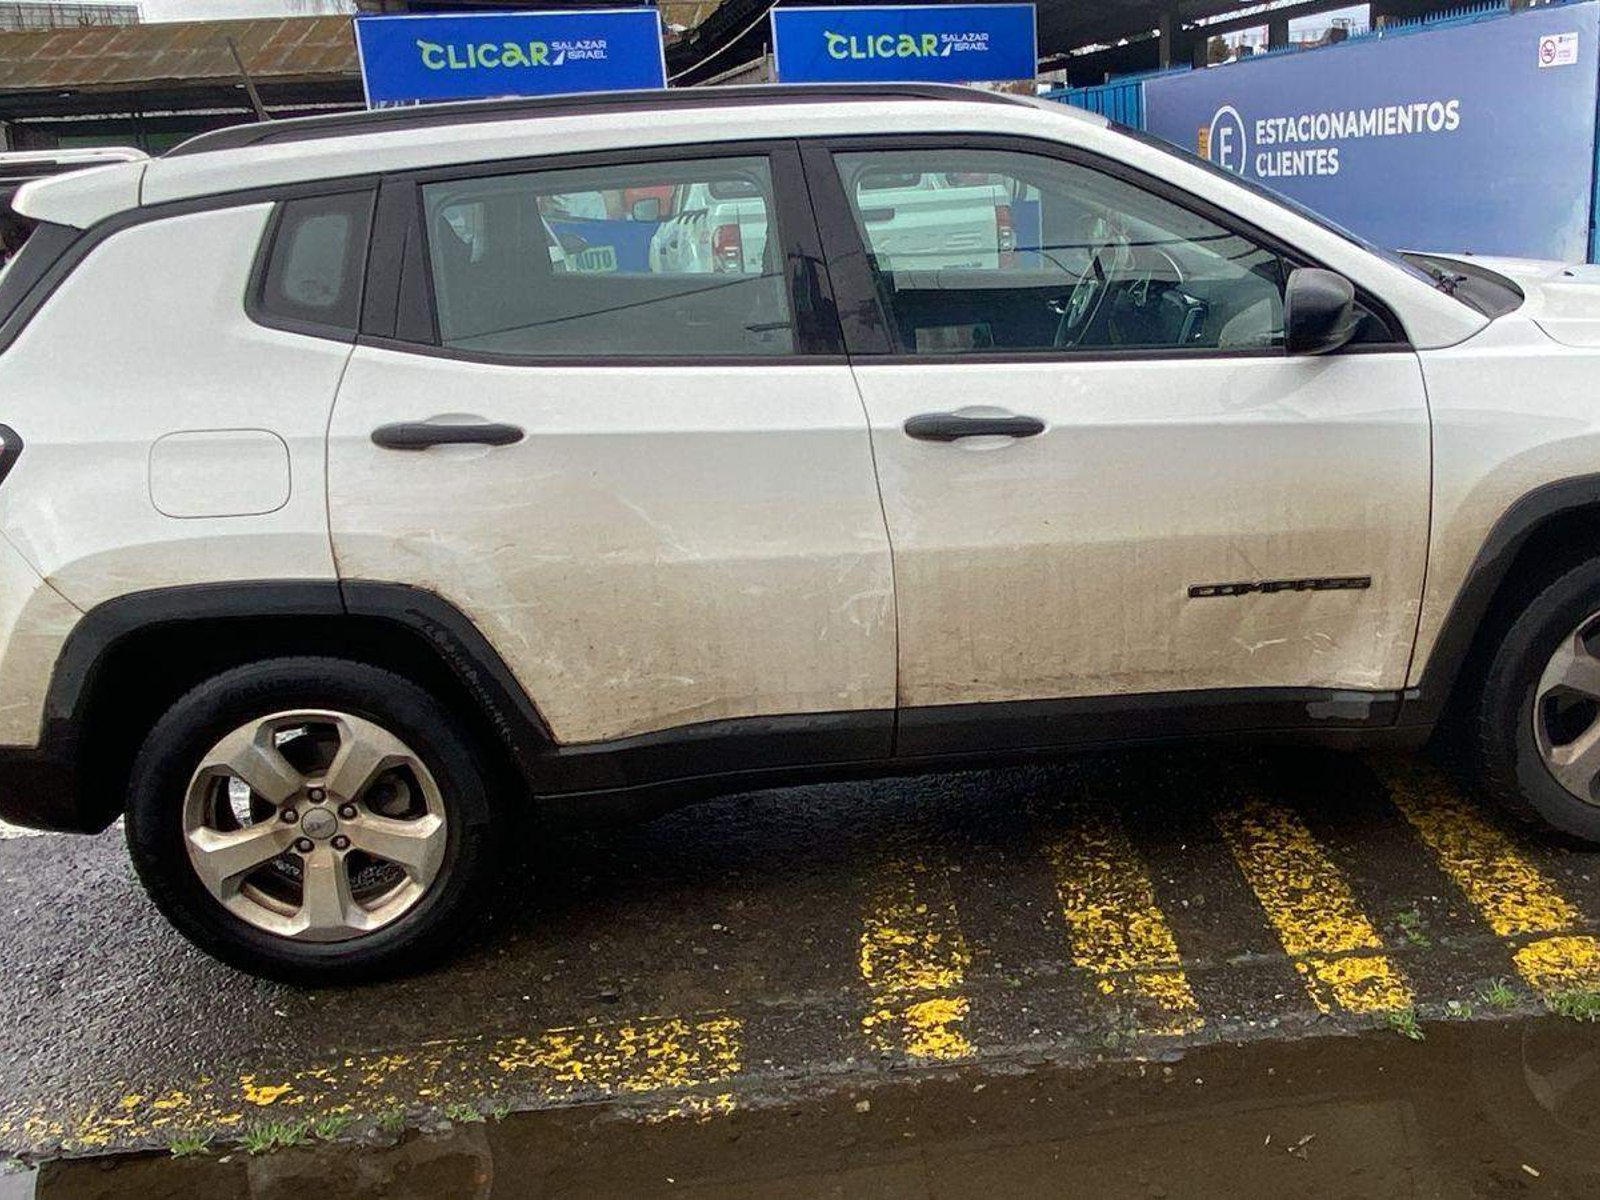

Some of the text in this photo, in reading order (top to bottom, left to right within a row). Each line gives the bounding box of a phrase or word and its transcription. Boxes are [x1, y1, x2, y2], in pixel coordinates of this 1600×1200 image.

[551, 40, 607, 51] SALAZAR
[940, 33, 989, 42] SALAZAR
[953, 42, 989, 51] ISRAEL
[1255, 99, 1460, 145] ESTACIONAMIENTOS
[1220, 127, 1233, 170] E
[1255, 147, 1340, 178] CLIENTES
